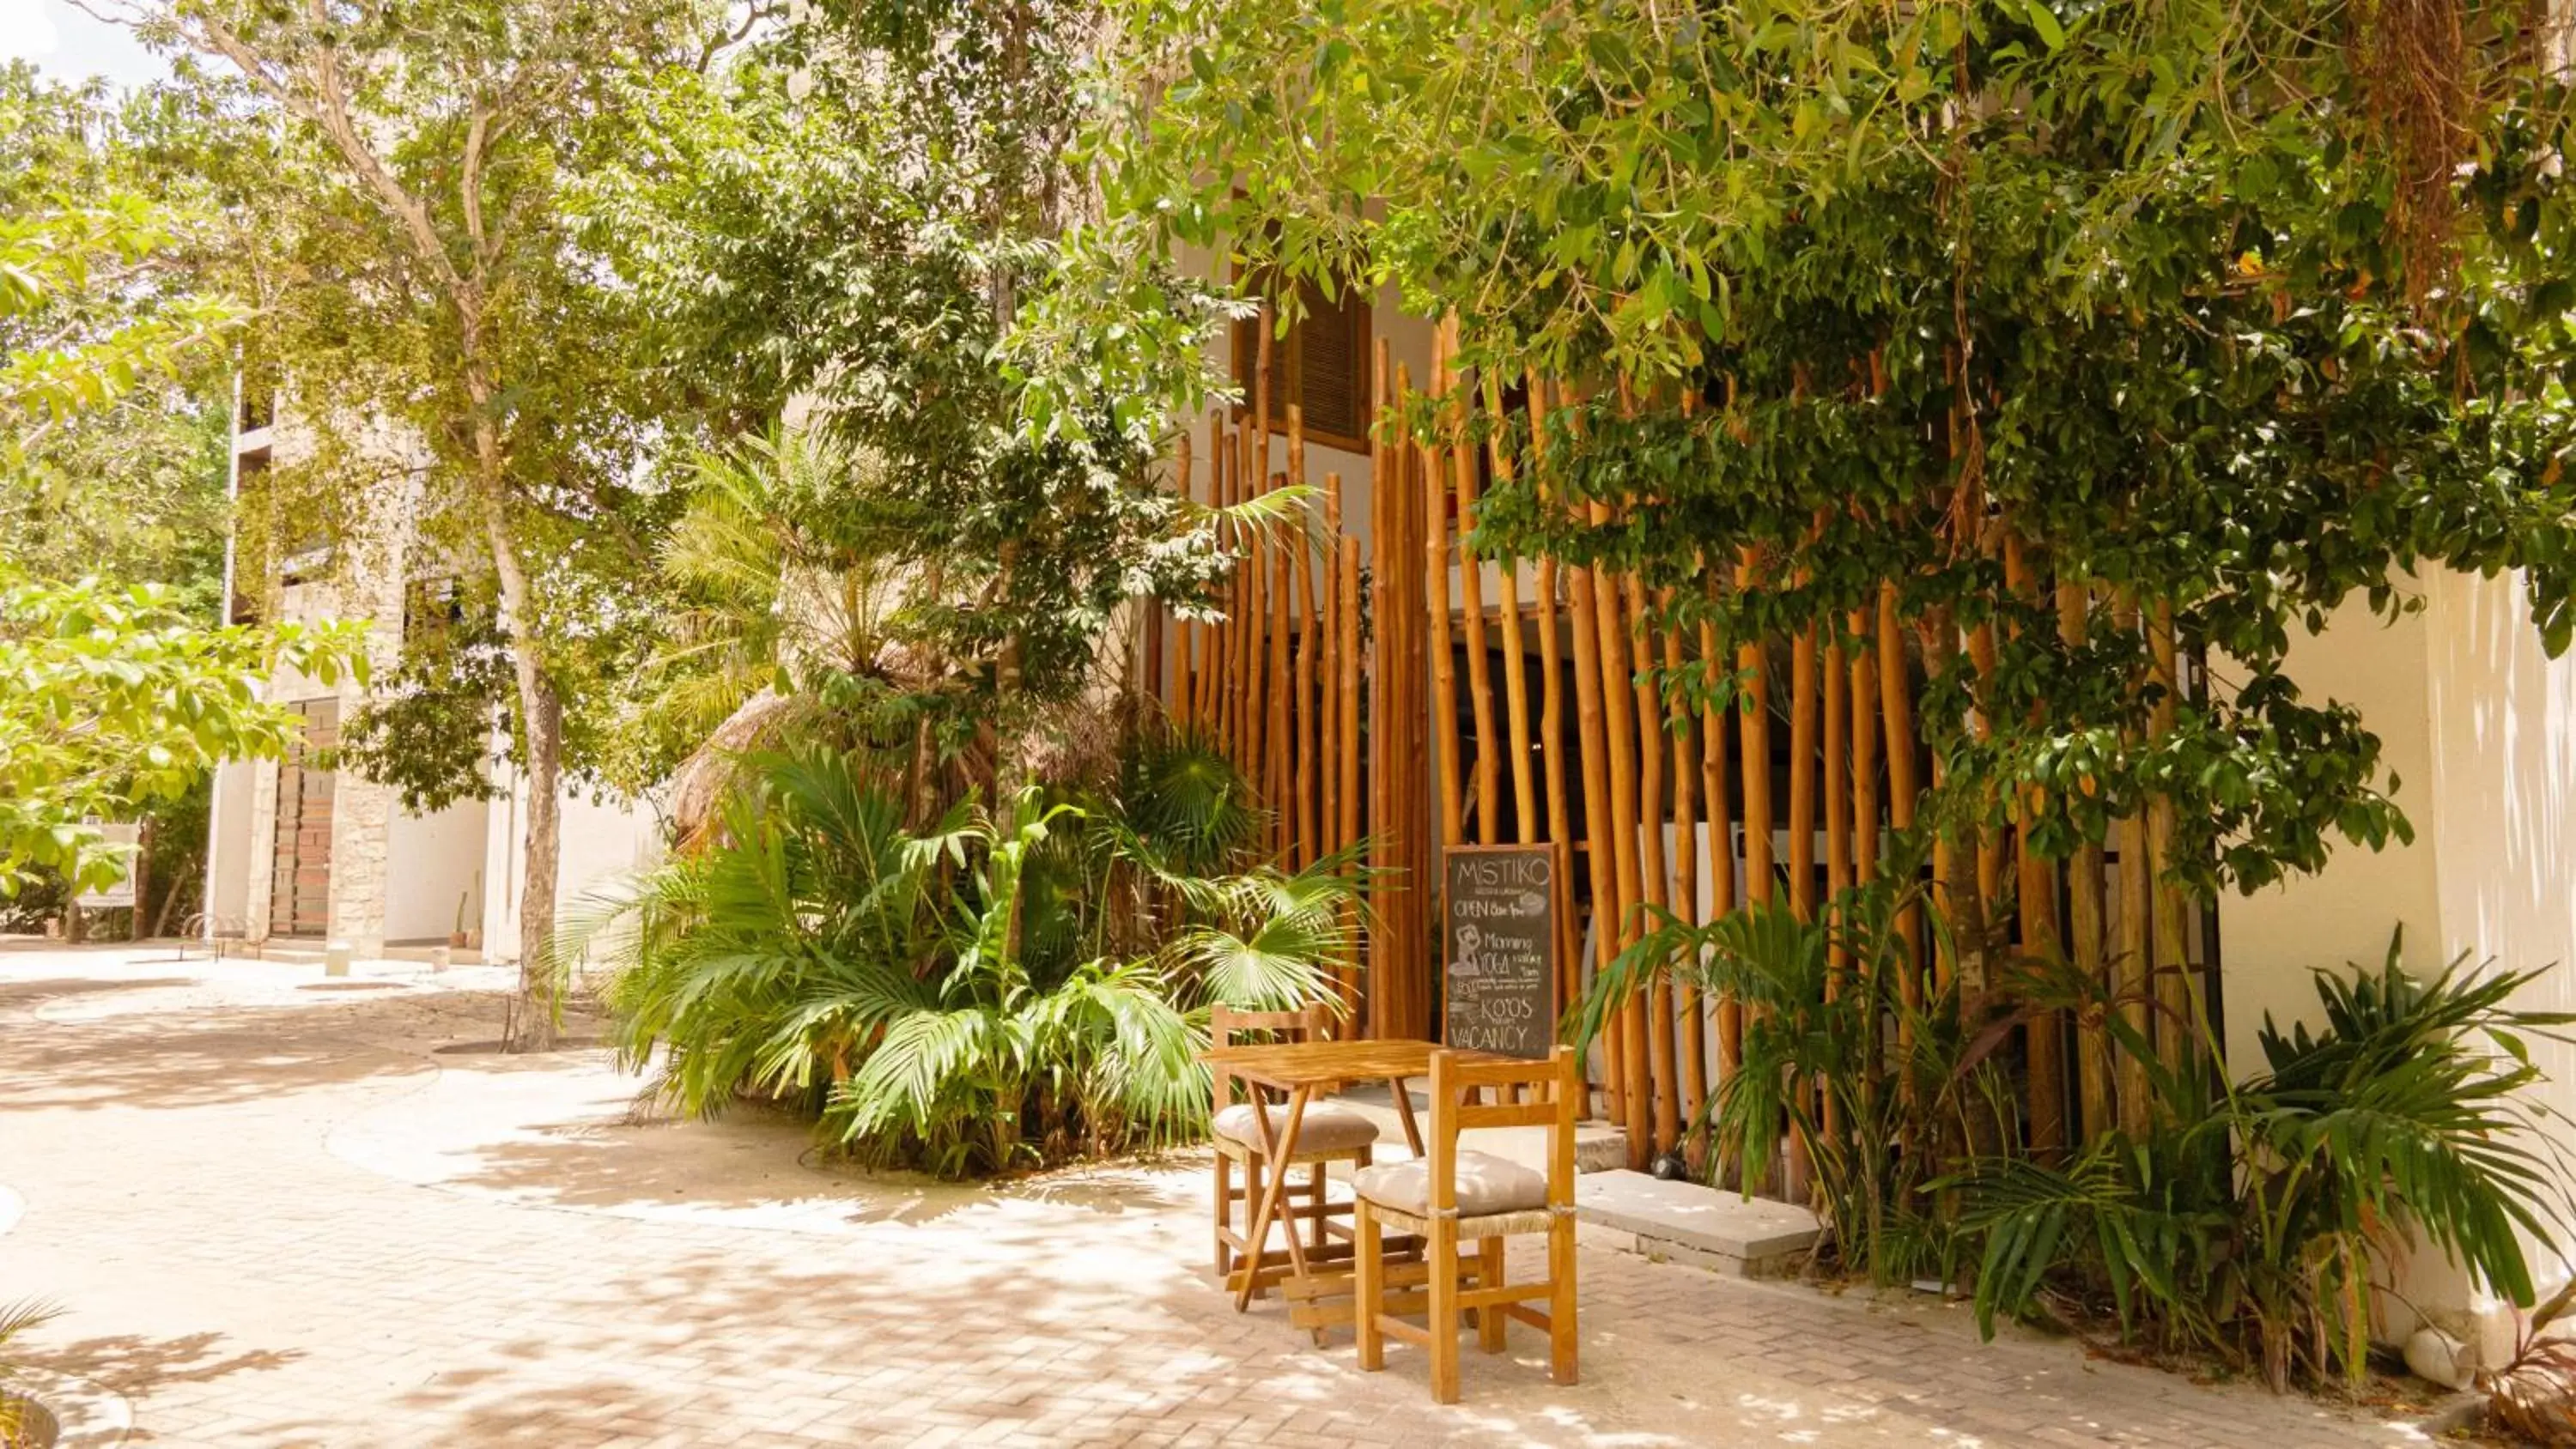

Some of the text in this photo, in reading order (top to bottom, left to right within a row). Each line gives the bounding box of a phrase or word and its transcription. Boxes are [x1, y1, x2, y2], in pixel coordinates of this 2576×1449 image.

[1457, 858, 1551, 886] MISTIKO
[1454, 900, 1488, 918] OPEN
[1484, 933, 1533, 958] Morning
[1479, 952, 1510, 976] YOGA
[1450, 1026, 1528, 1051] VACANCY
